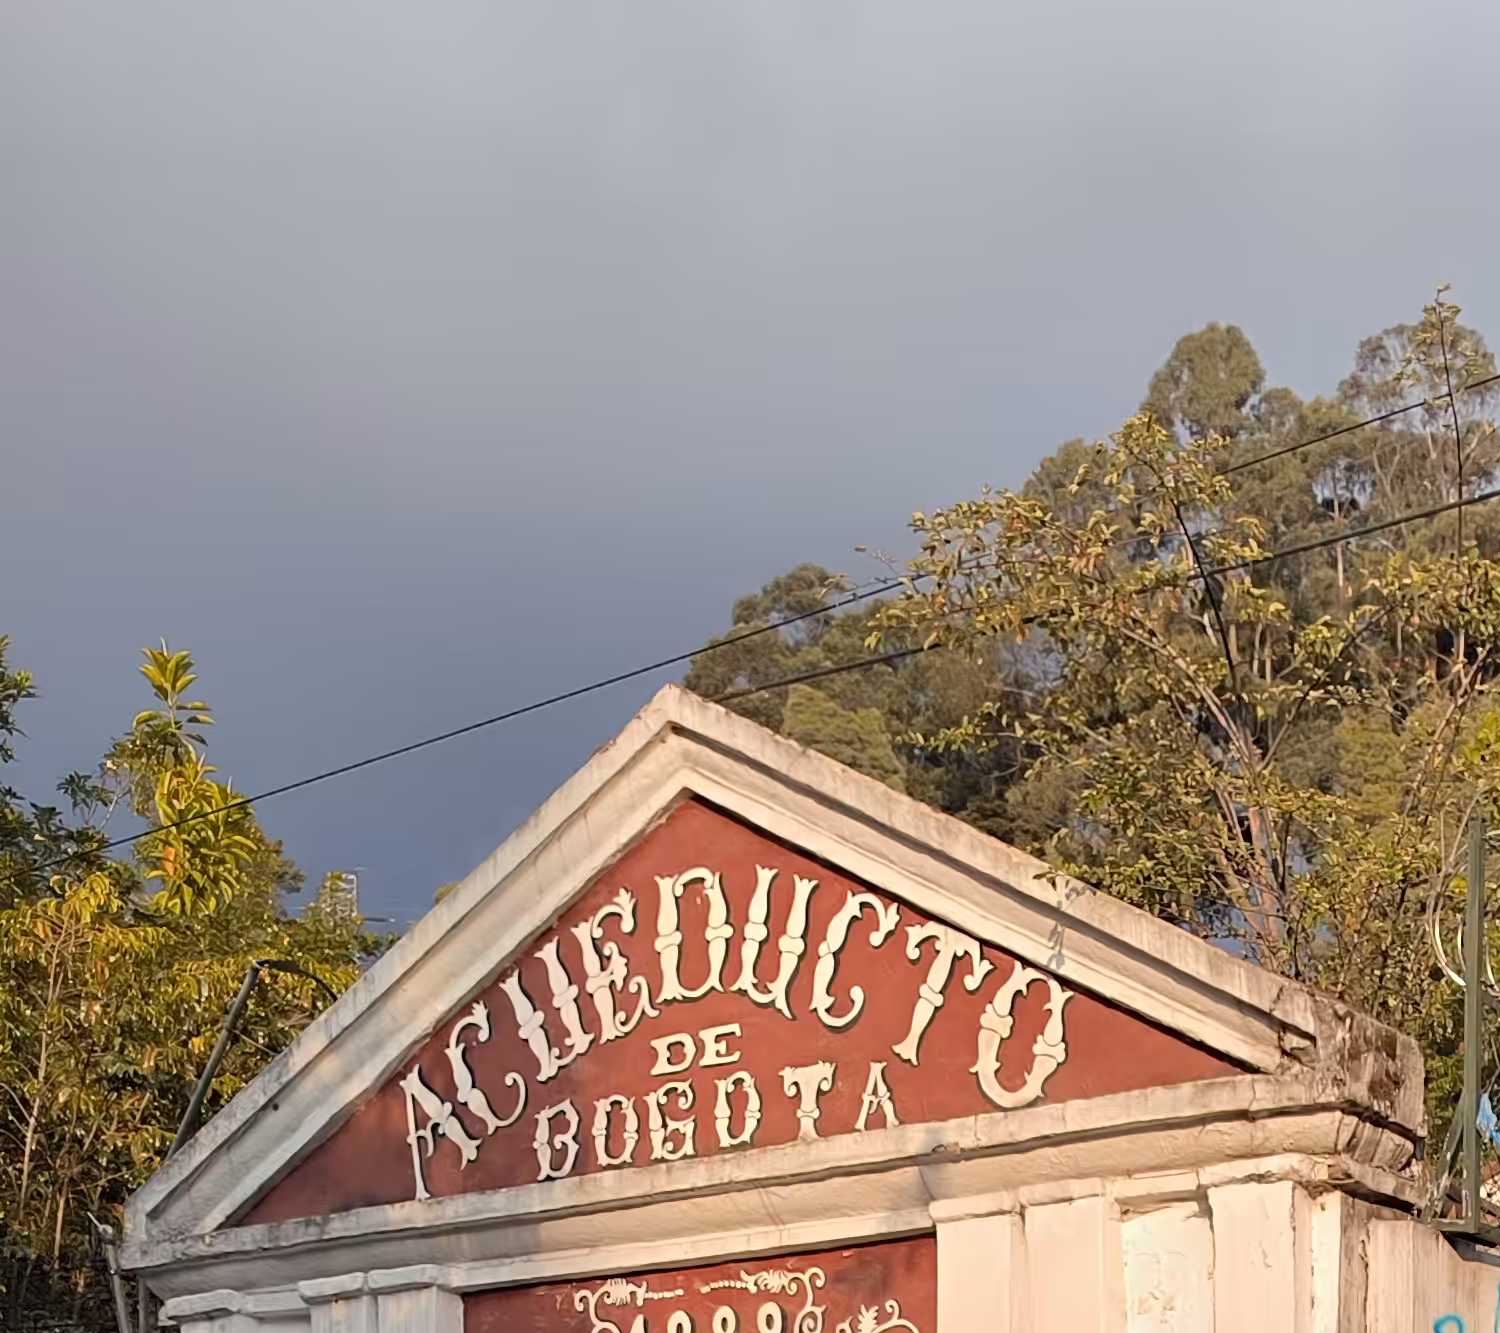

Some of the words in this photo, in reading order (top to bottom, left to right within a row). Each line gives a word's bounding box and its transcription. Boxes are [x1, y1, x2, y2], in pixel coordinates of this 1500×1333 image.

[399, 863, 1075, 1201] ACUEDUCTO
[650, 1022, 743, 1076] DE
[532, 1060, 901, 1181] BOGOTA
